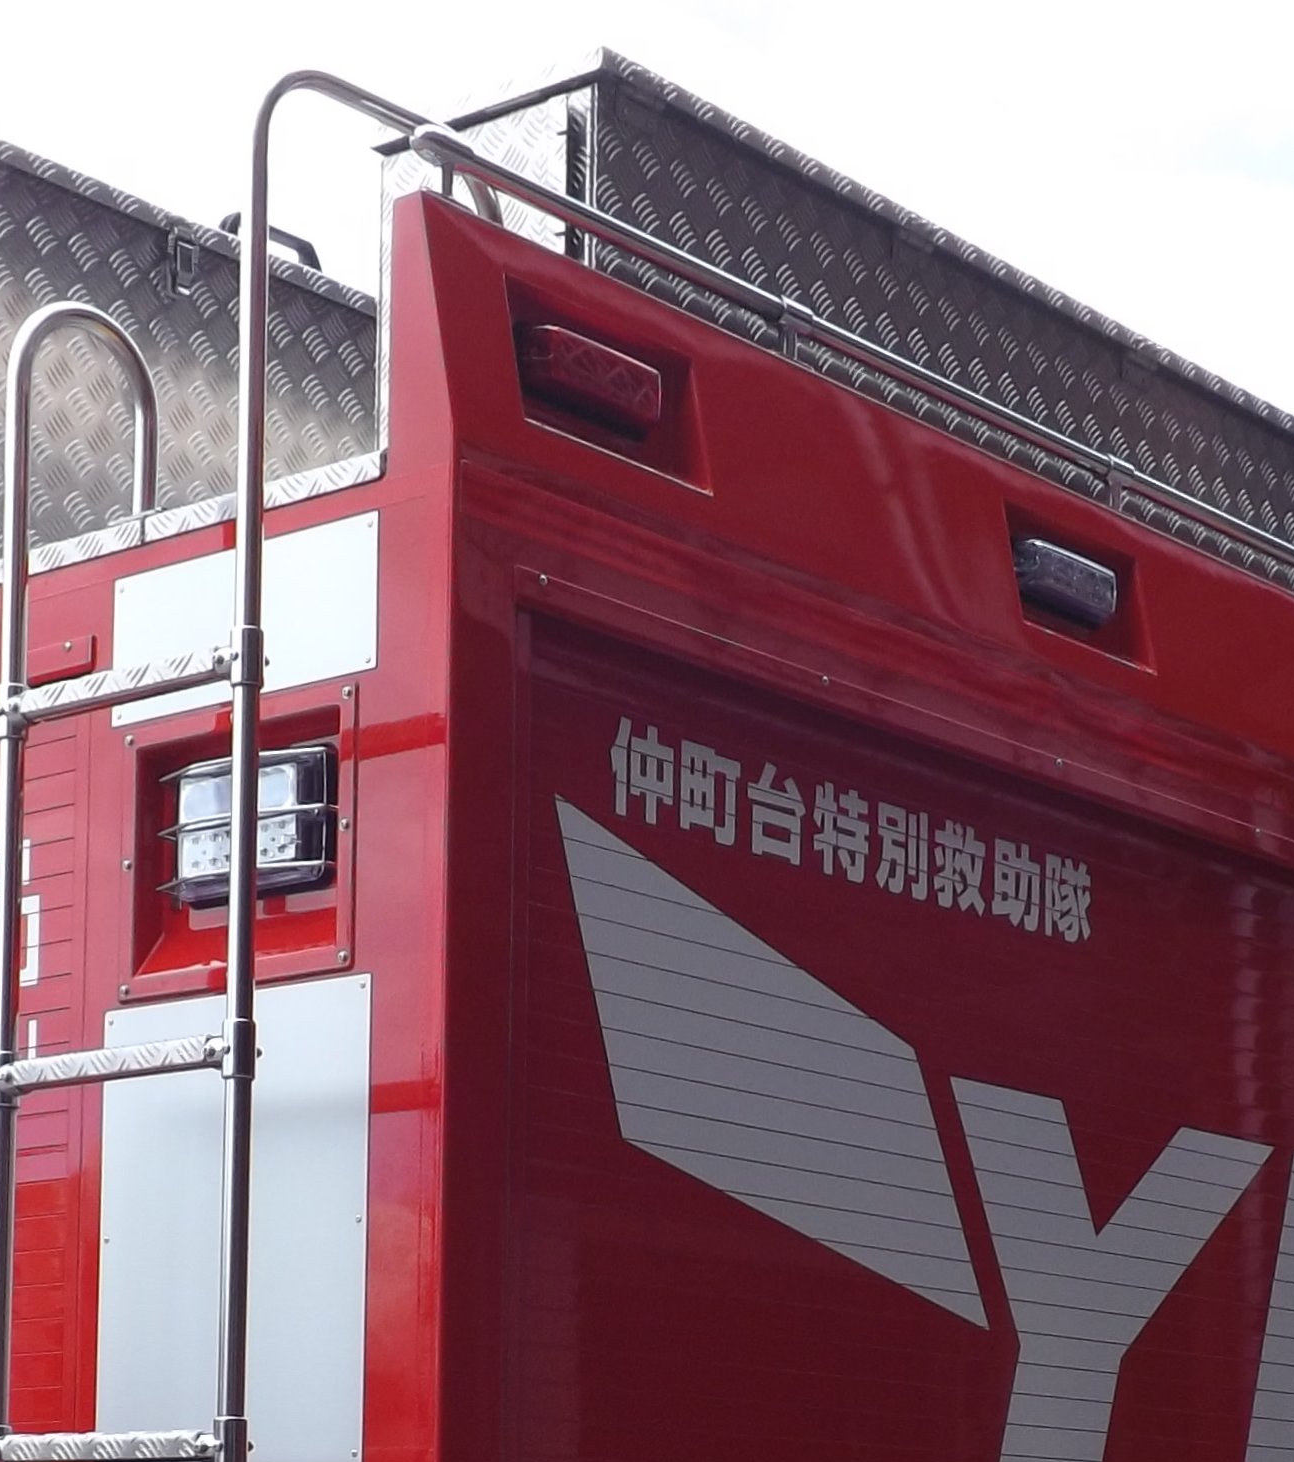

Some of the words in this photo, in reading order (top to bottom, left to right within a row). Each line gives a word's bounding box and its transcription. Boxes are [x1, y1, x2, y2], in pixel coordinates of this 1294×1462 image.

[609, 716, 1093, 941] 仲町台特別救助隊
